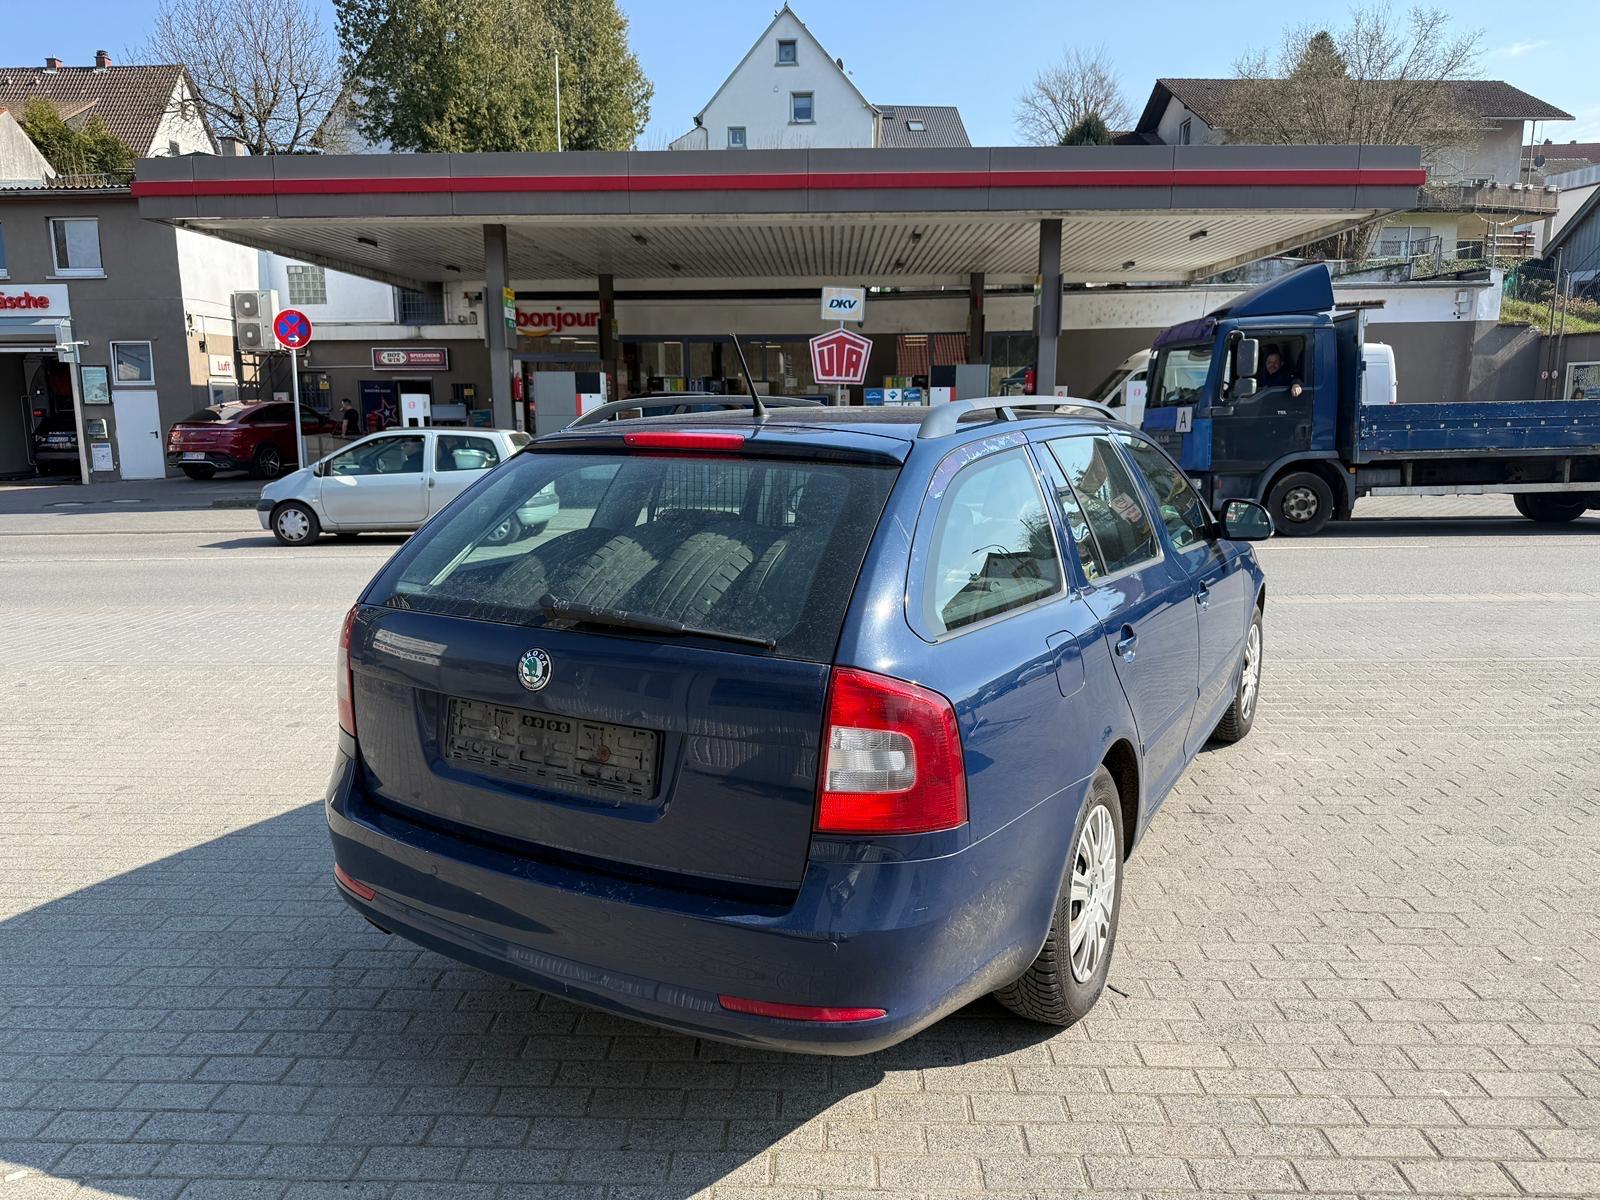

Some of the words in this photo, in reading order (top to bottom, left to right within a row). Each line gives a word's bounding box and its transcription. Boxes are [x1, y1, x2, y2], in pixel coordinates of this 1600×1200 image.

[829, 299, 857, 309] DKV
[515, 306, 600, 332] bonjour
[217, 360, 231, 371] Luft
[817, 335, 865, 377] UTA
[1179, 410, 1187, 429] A
